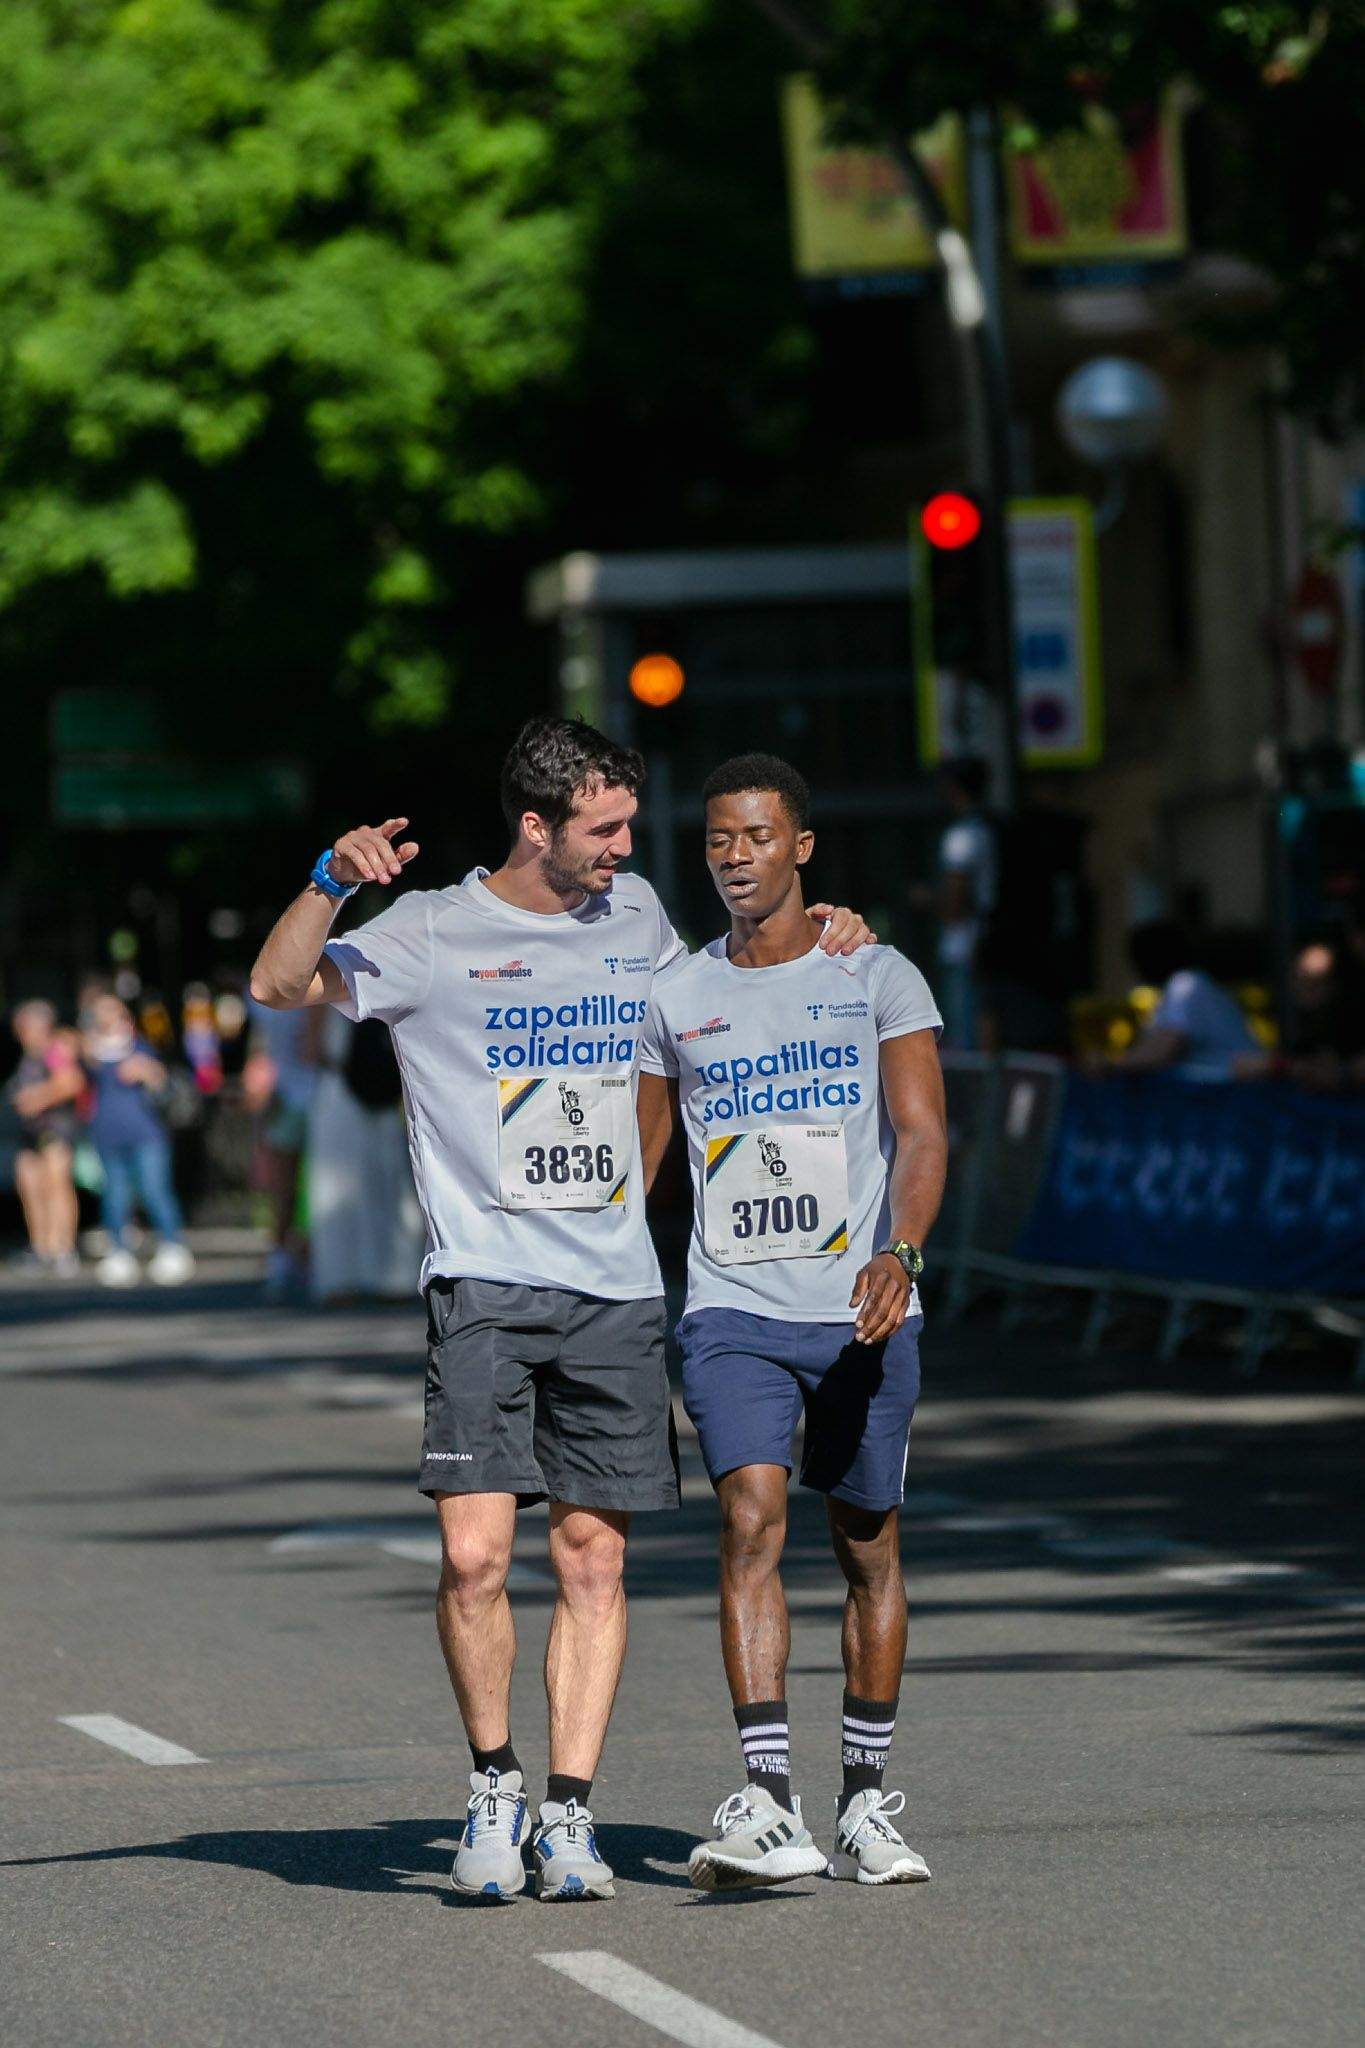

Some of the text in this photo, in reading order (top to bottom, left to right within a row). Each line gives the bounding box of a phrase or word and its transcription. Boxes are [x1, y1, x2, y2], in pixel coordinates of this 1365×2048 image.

[469, 967, 533, 979] beyourimpulse
[485, 995, 646, 1035] zapatillas
[828, 1001, 868, 1010] Fundación
[829, 1010, 868, 1018] Telefónica
[486, 1033, 639, 1068] solidaria
[703, 1077, 861, 1123] solidarias
[571, 1112, 581, 1122] 13
[525, 1144, 614, 1184] 3836
[772, 1163, 784, 1173] 13
[732, 1193, 819, 1239] 3700
